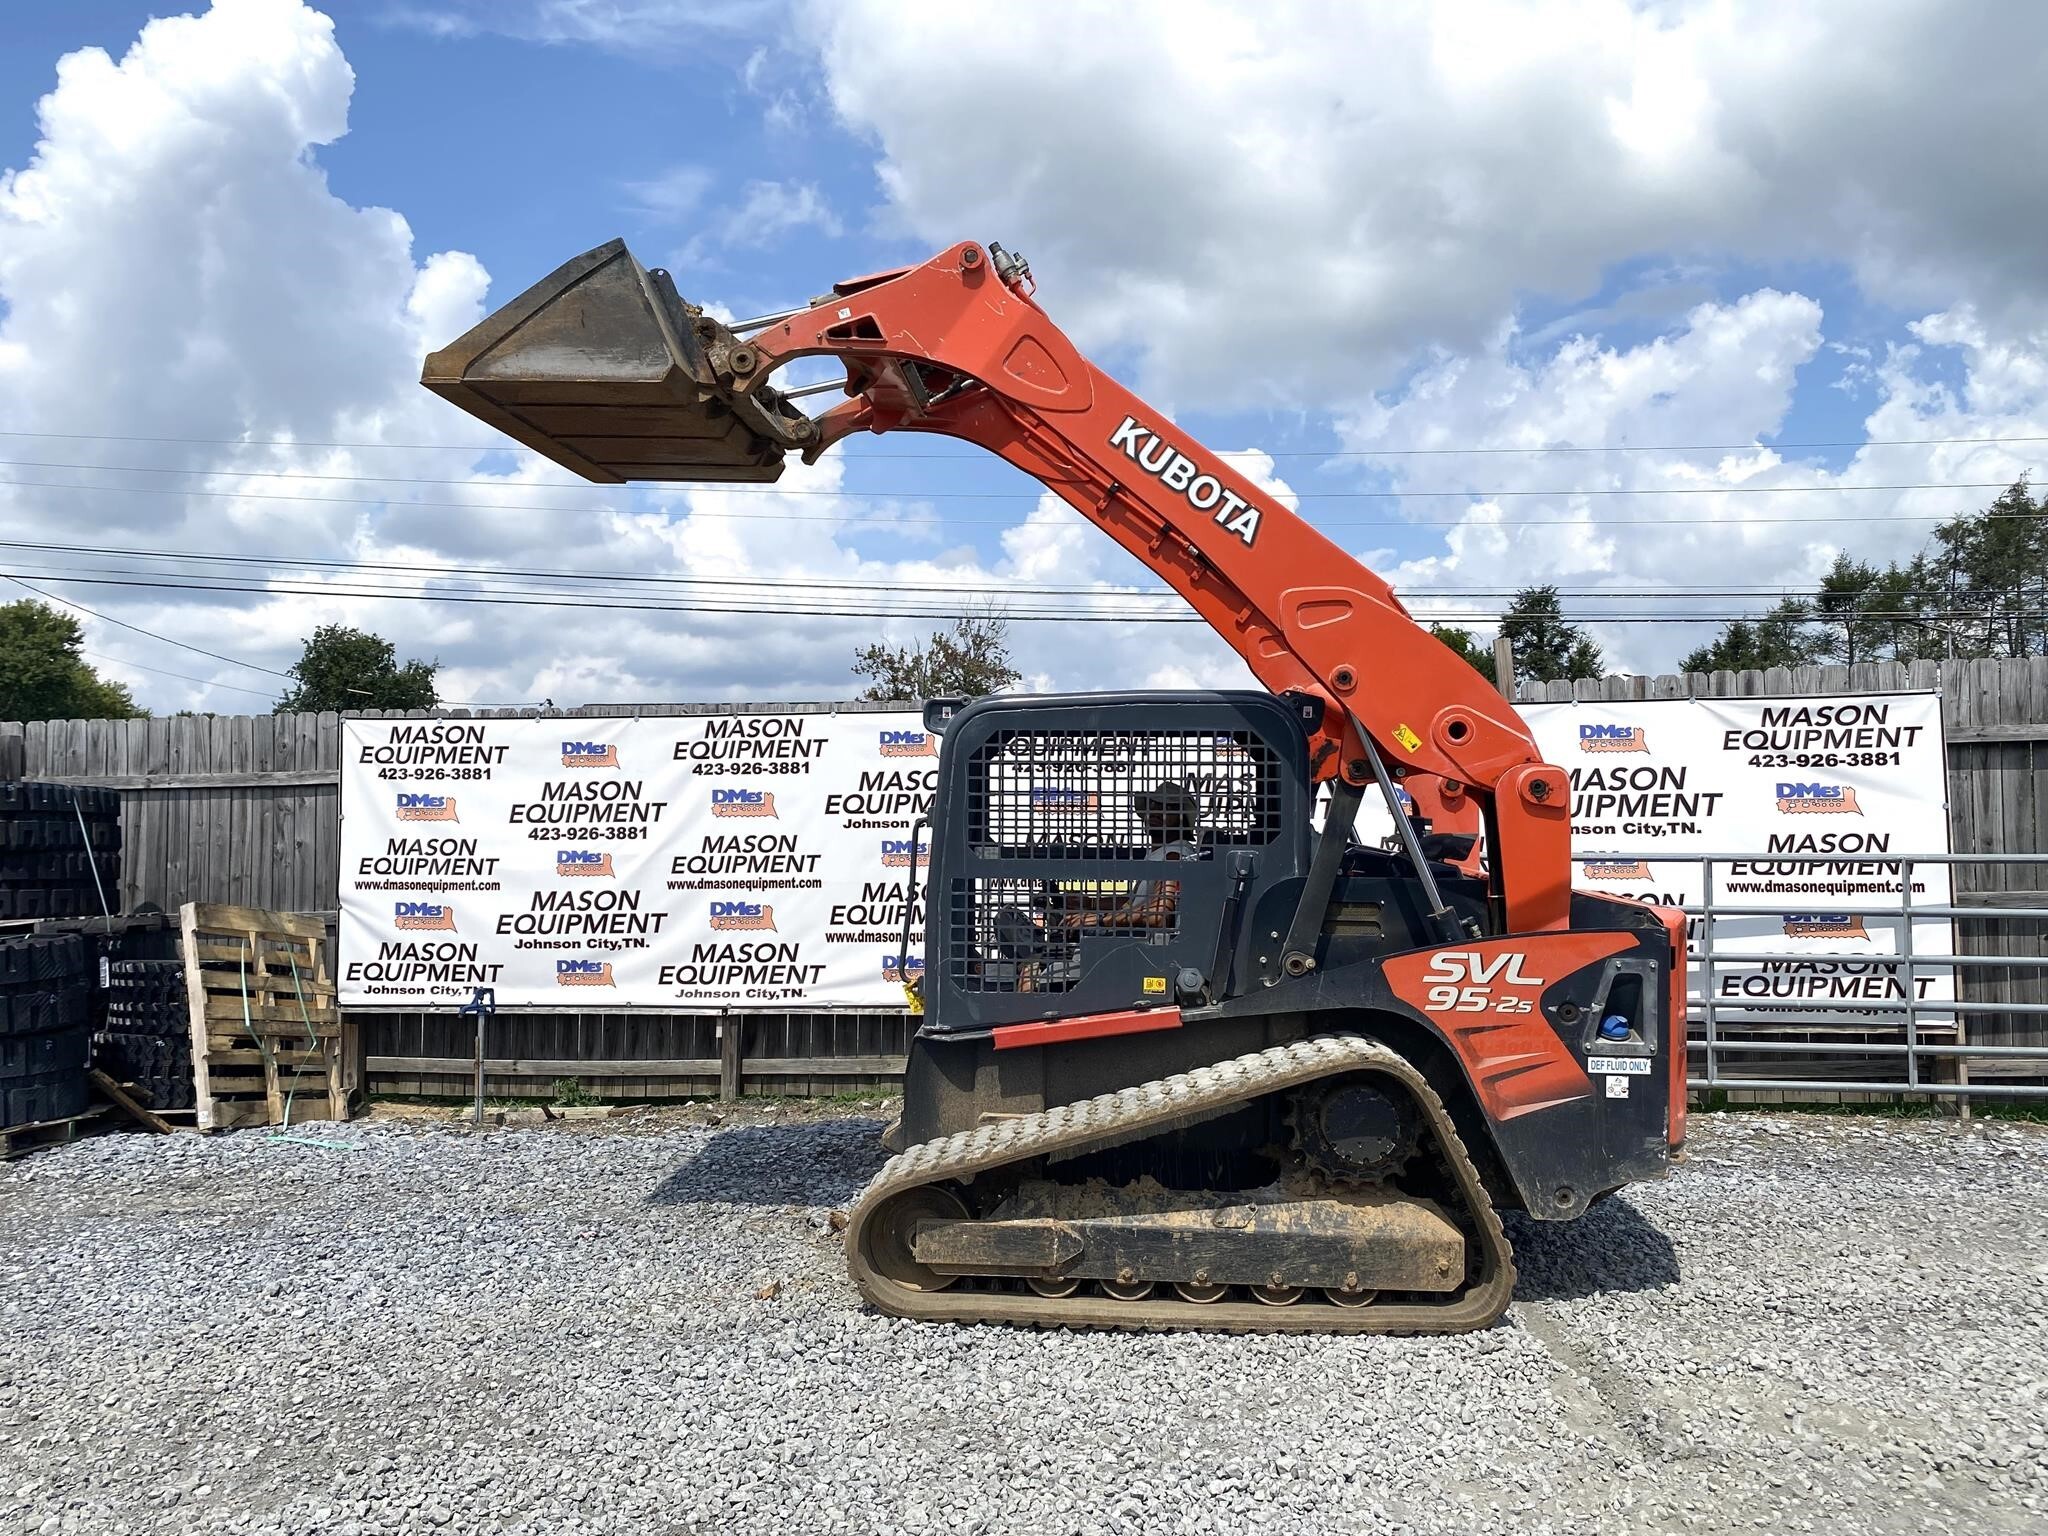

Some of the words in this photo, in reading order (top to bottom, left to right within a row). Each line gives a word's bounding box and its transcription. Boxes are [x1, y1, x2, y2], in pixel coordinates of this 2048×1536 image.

[1109, 415, 1262, 547] KUBOTA
[1762, 704, 1888, 727] MASON
[389, 725, 485, 744] MASON
[705, 718, 803, 738] MASON
[1723, 726, 1923, 750] EQUIPMENT
[359, 746, 509, 764] EQUIPMENT
[673, 739, 828, 760] EQUIPMENT
[692, 762, 809, 776] 423-926-3881
[1749, 752, 1900, 767] 423-926-3881
[378, 768, 491, 780] 423-926-3881
[859, 770, 938, 792] MASO
[541, 781, 642, 801] MASON
[510, 803, 667, 823] EQUIPMENT
[825, 794, 937, 815] EQUIPM
[1570, 793, 1723, 817] UIPMENT
[528, 826, 647, 840] 423-926-3881
[843, 819, 909, 829] Johnson
[1571, 824, 1616, 835] nson
[387, 839, 477, 856] MASON
[702, 835, 797, 854] MASON
[1768, 834, 1889, 853] MASON
[359, 858, 499, 875] EQUIPMENT
[672, 855, 821, 874] EQUIPMENT
[1731, 861, 1914, 876] EQUIPMEN
[355, 879, 500, 893] www.dmasonequipment.com
[667, 877, 822, 892] www.dmasonequipment.com
[1727, 880, 1925, 896] www.dmasonequipment.cm
[531, 890, 640, 911] MASON
[496, 913, 668, 934] EQUIPMENT
[379, 942, 477, 961] MASON
[514, 939, 580, 949] Johnson
[692, 943, 799, 963] MASON
[346, 963, 504, 982] EQUIPMENT
[659, 965, 826, 985] EQUIPMENT
[1422, 952, 1544, 985] SVL
[363, 985, 425, 995] Johnson
[430, 986, 476, 997] City,T
[675, 989, 740, 999] Johnson
[1721, 975, 1935, 999] EQUIPMENT
[1591, 1060, 1605, 1070] DEF
[1607, 1061, 1627, 1071] FLUID
[1629, 1061, 1648, 1071] ONLY
